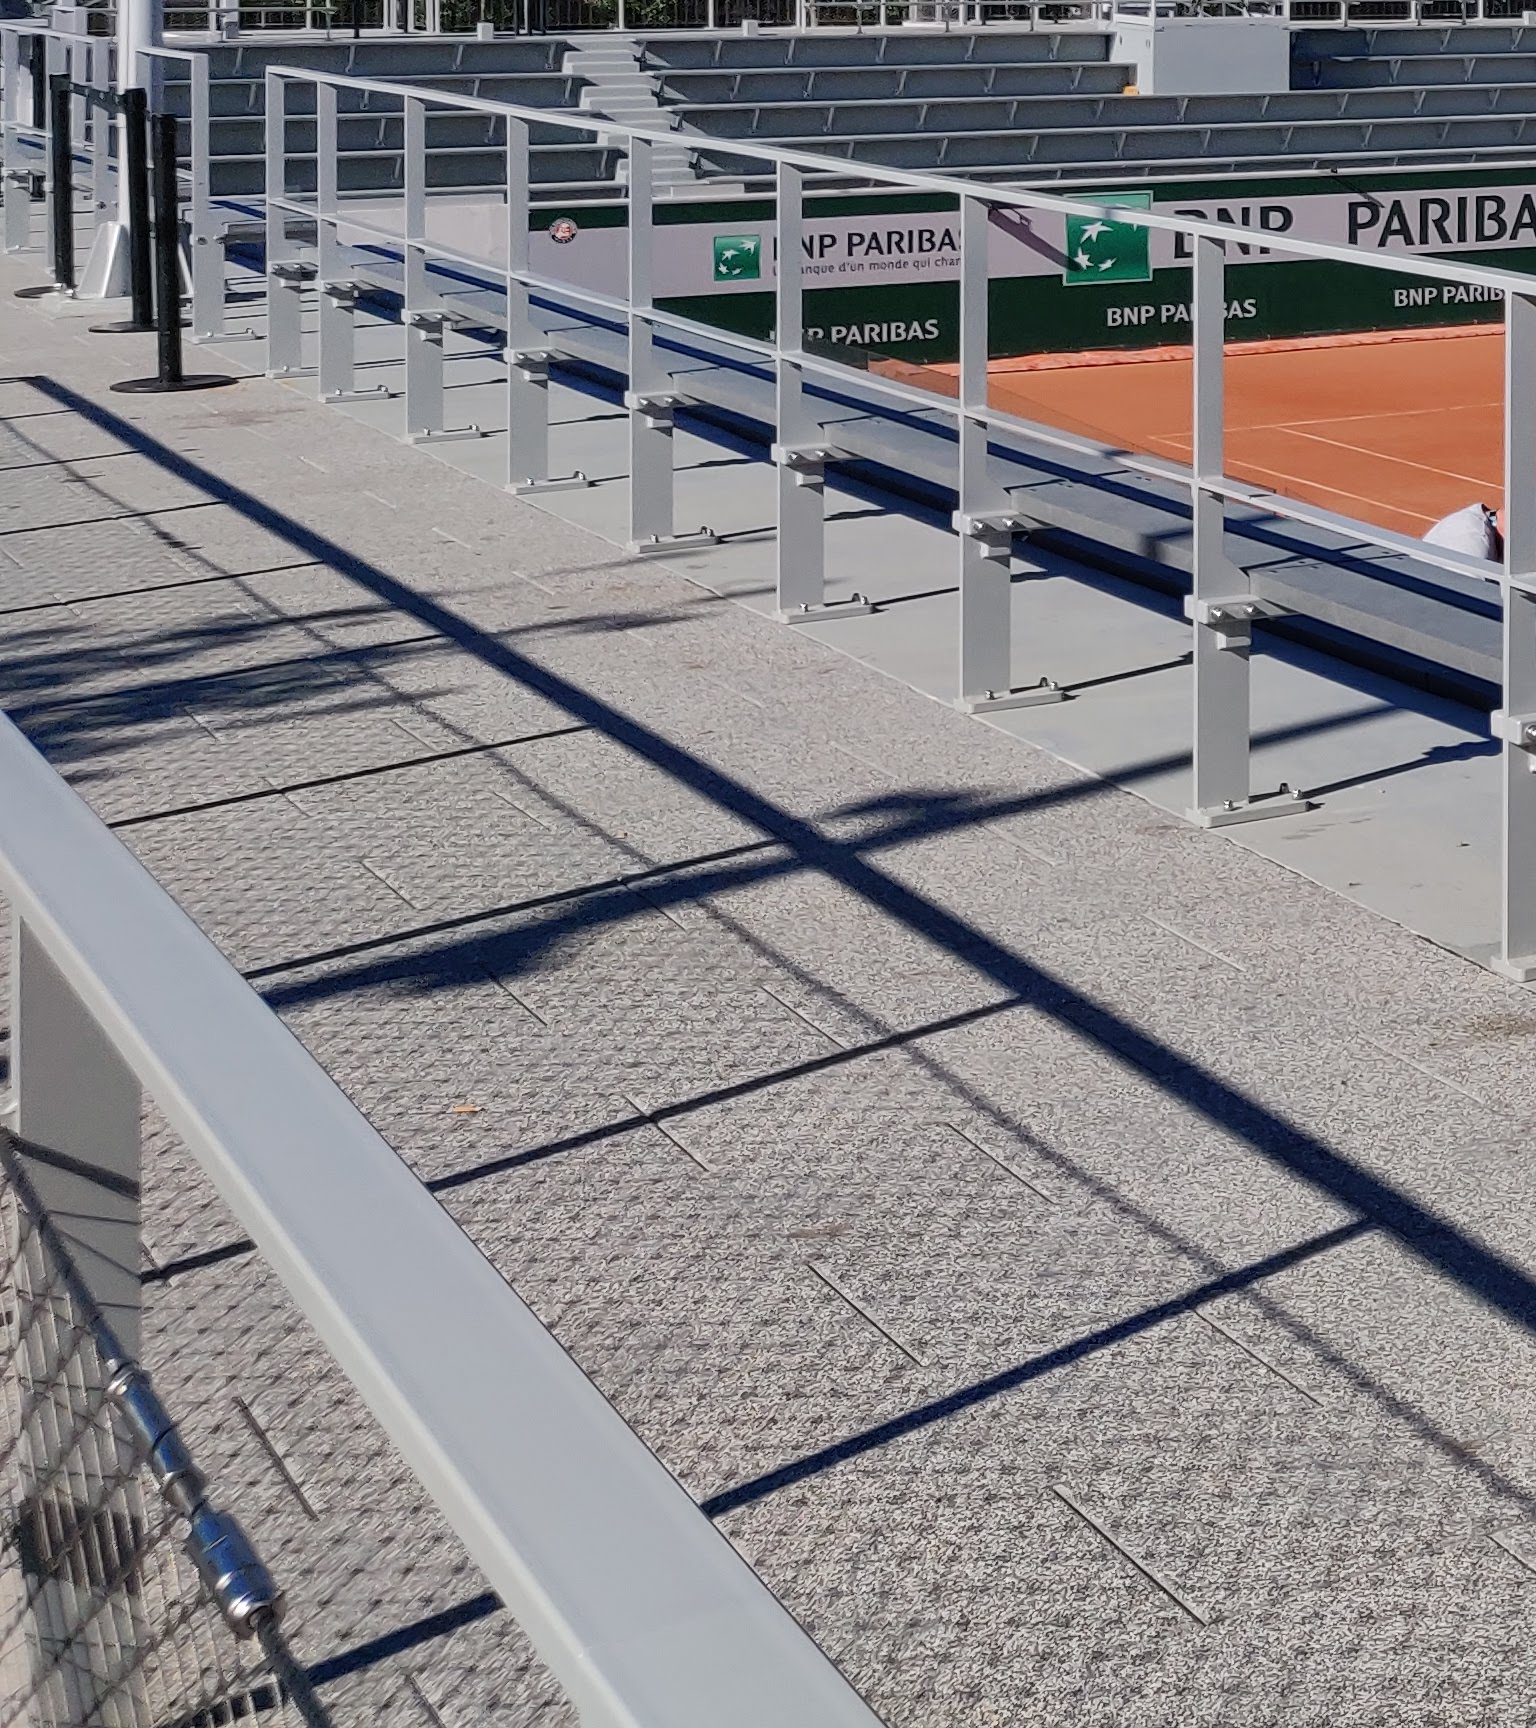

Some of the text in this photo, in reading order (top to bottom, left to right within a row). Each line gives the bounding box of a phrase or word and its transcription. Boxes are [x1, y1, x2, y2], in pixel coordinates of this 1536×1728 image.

[847, 228, 961, 257] PARIBA
[838, 260, 864, 272] d'un
[869, 256, 909, 271] monde
[913, 254, 931, 269] qui
[1394, 283, 1505, 307] BNP PARIB
[1106, 304, 1155, 327] BNP
[831, 319, 939, 345] PARIBAS
